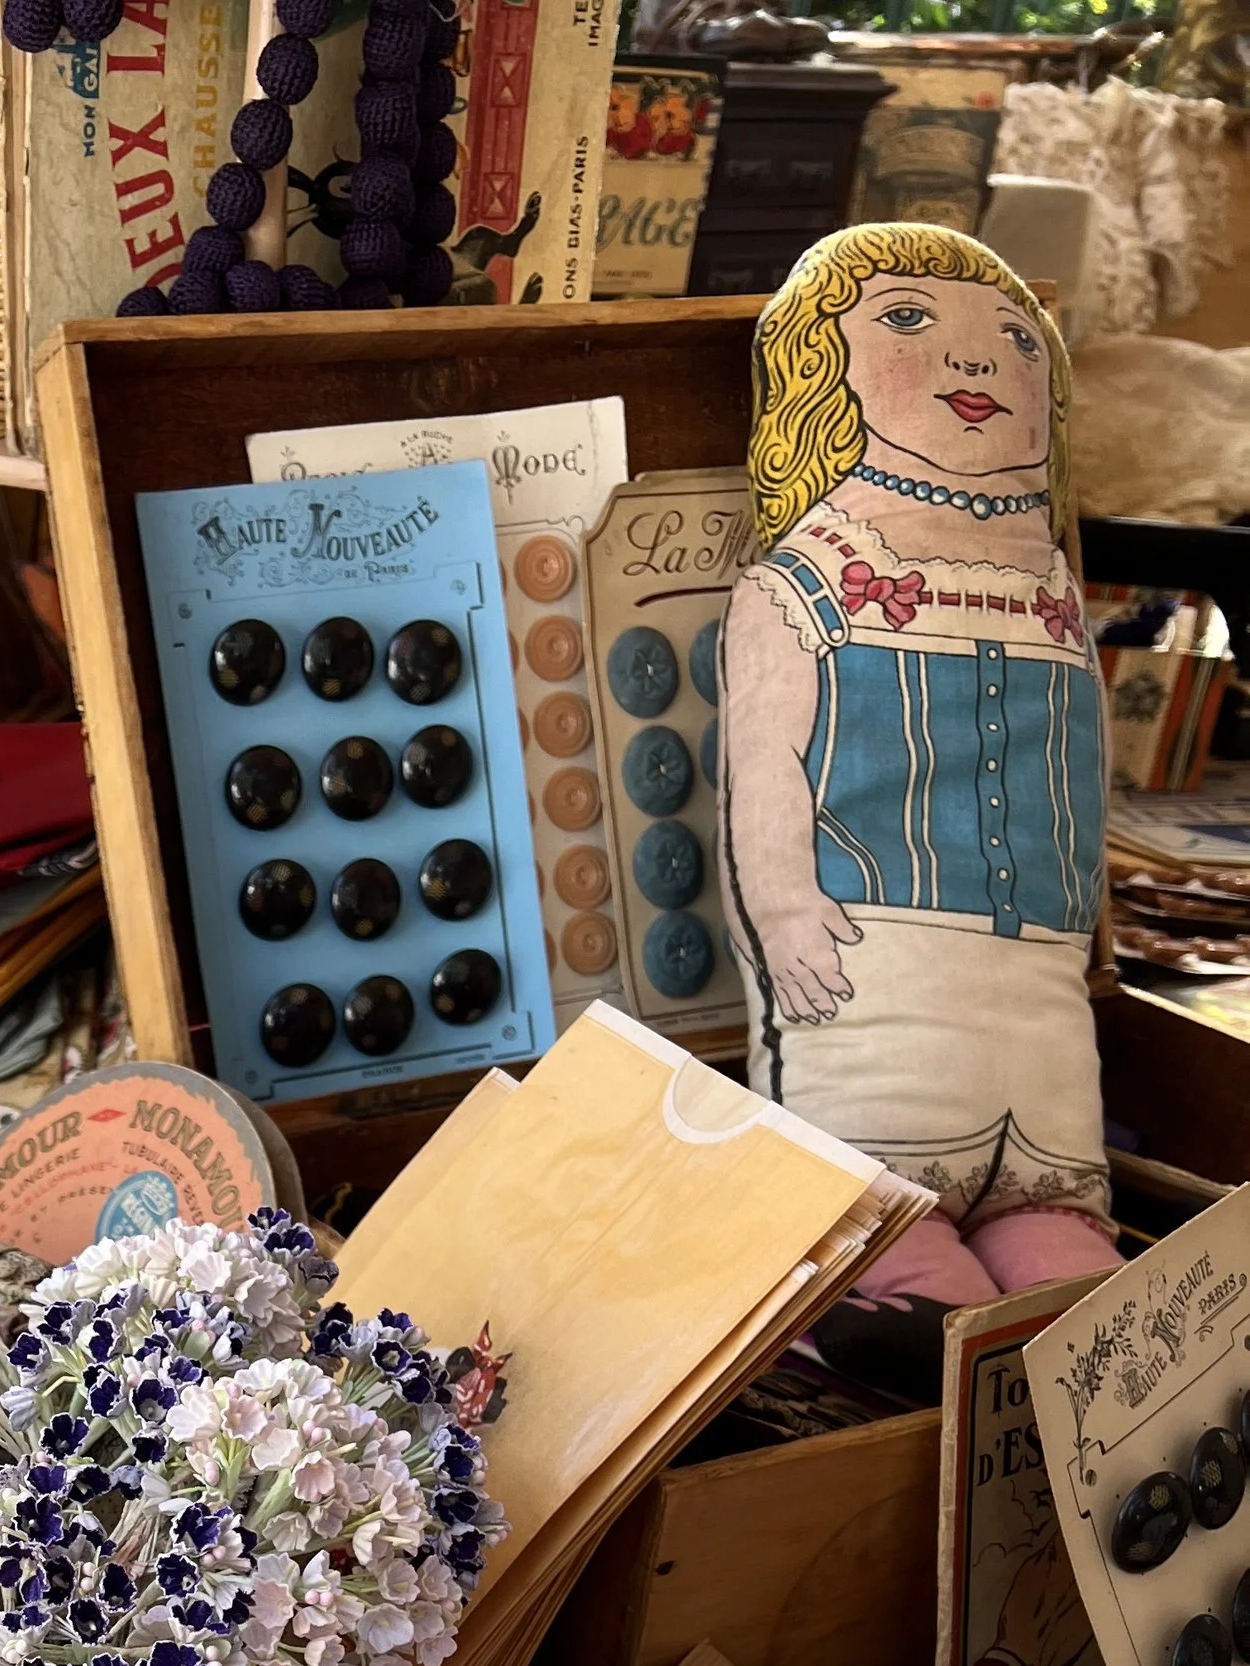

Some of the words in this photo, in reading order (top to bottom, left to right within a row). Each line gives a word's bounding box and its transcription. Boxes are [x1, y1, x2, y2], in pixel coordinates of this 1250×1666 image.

[83, 104, 97, 158] MON
[198, 515, 287, 566] HAUTE
[290, 496, 440, 562] NOUVEAUTÉ
[622, 509, 691, 577] La
[1121, 1351, 1168, 1410] HAUTE
[1150, 1250, 1215, 1363] NOUVEAUTÉ
